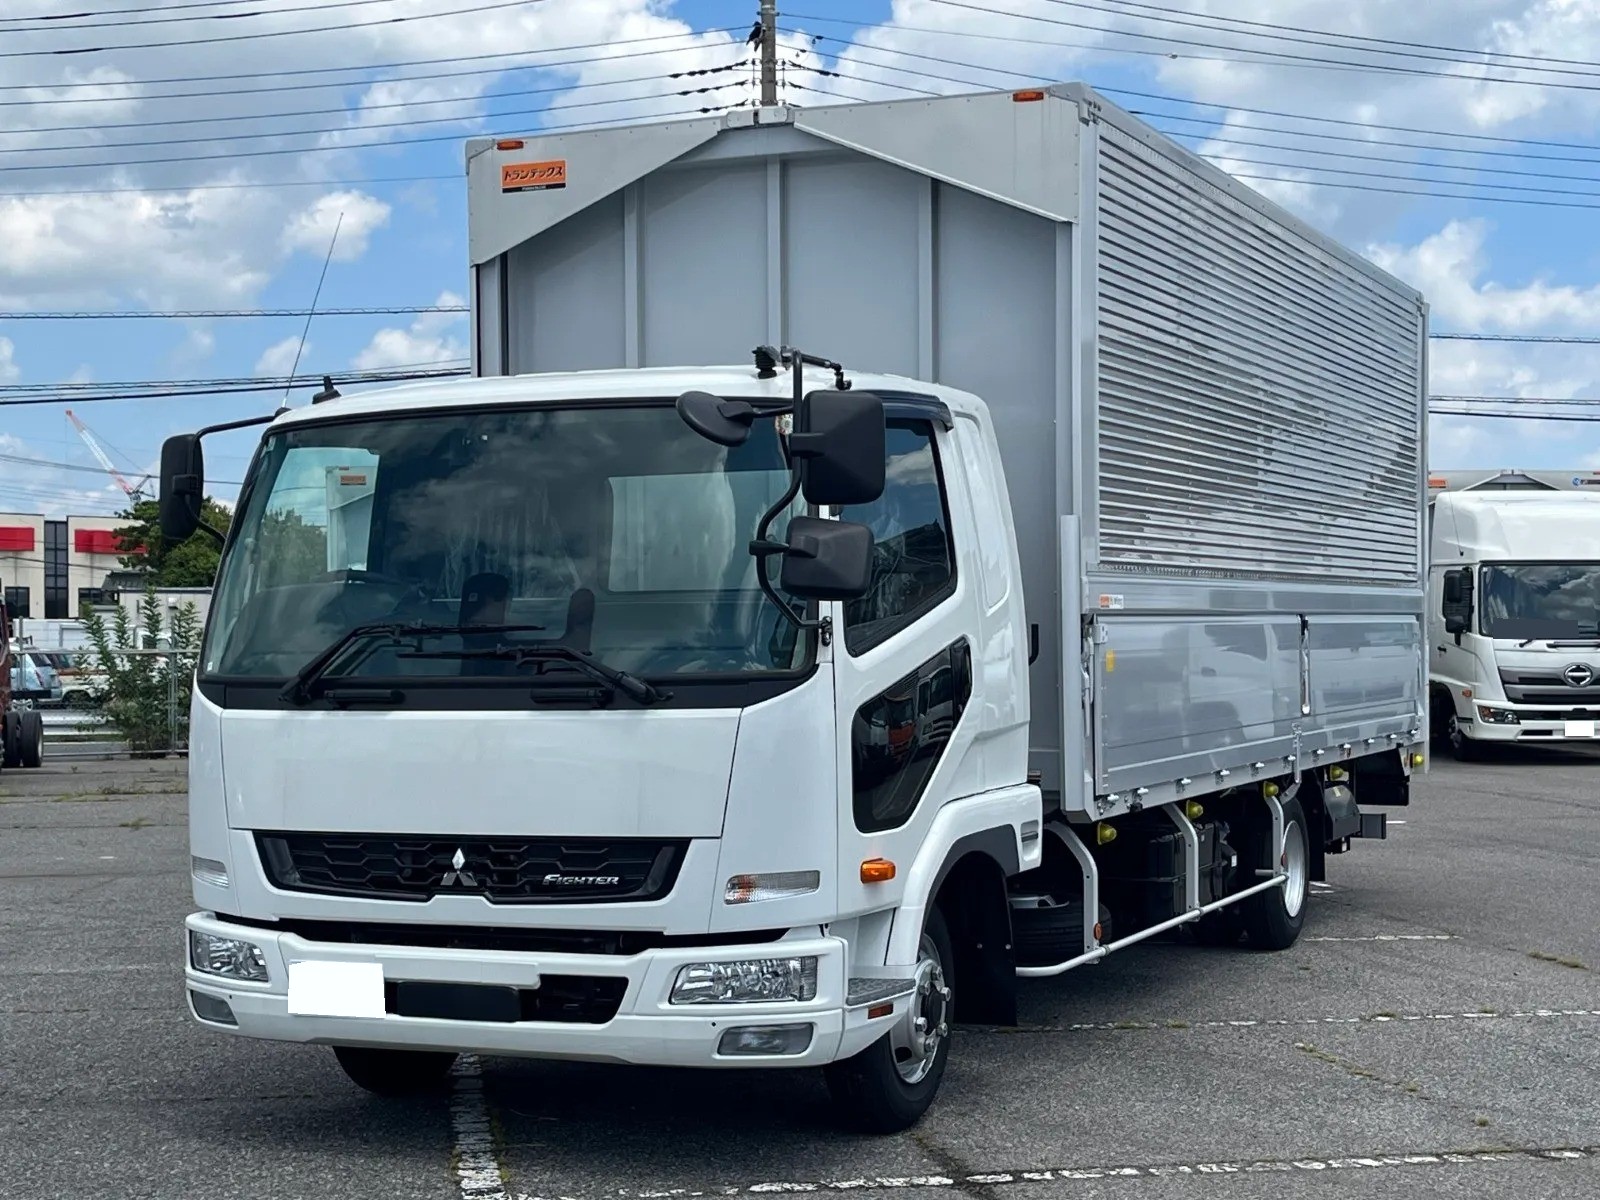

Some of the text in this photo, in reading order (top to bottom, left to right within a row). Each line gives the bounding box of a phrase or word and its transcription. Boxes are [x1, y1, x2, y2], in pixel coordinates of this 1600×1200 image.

[504, 166, 562, 181] トランテックス
[542, 874, 619, 885] FIGHTER
